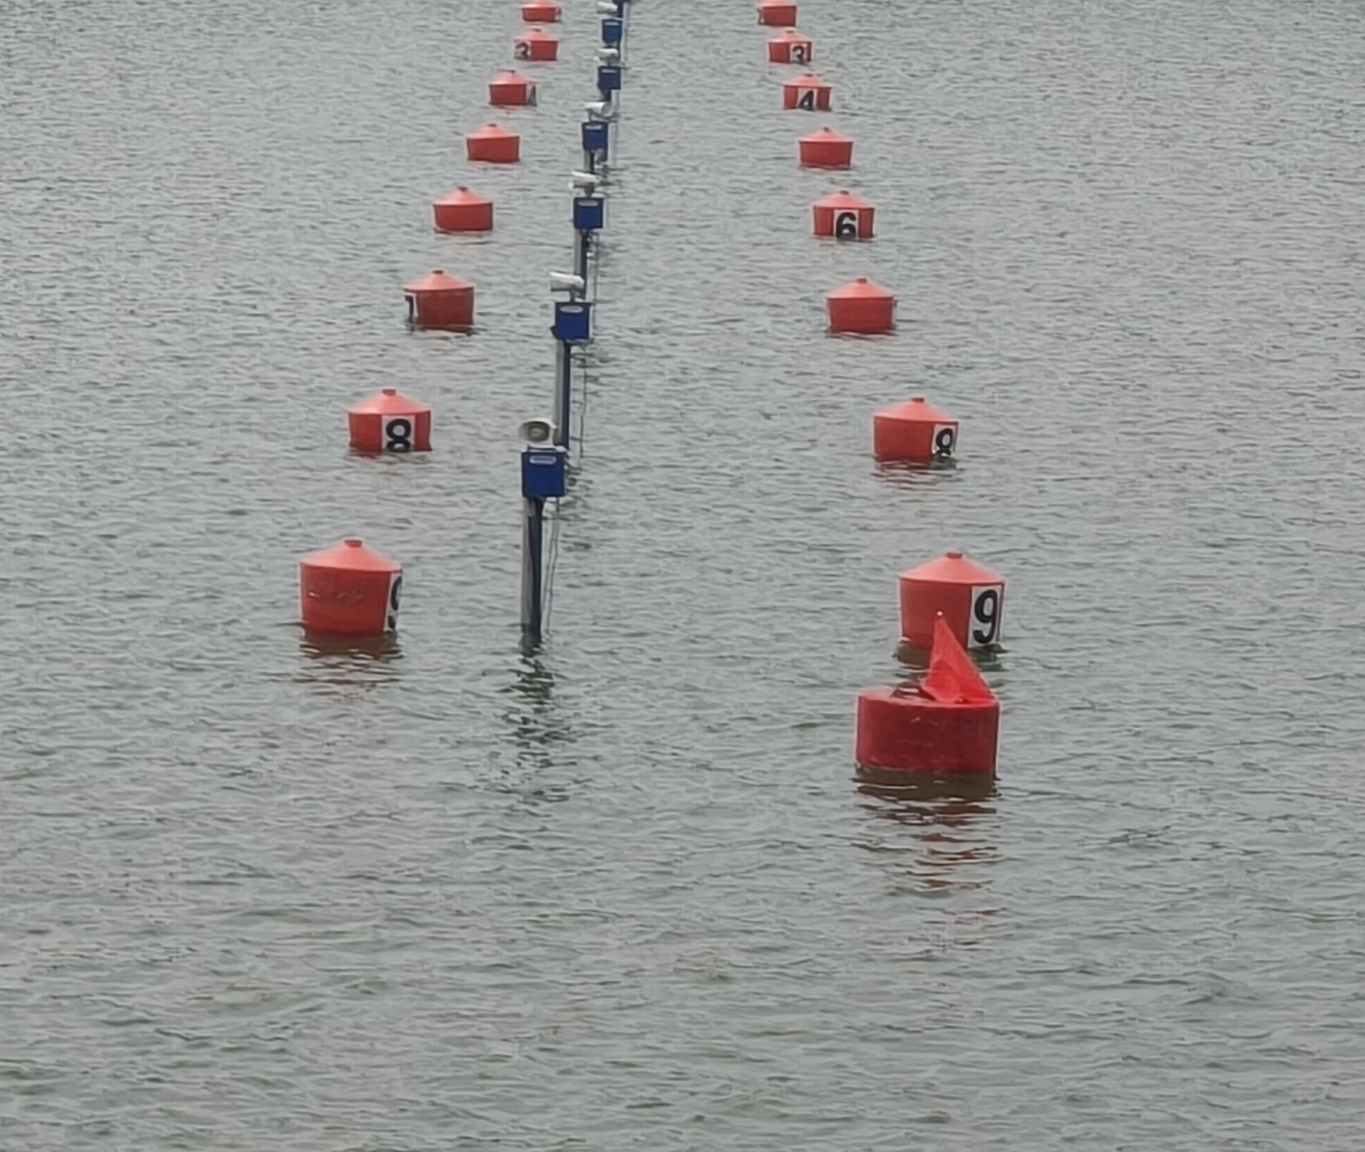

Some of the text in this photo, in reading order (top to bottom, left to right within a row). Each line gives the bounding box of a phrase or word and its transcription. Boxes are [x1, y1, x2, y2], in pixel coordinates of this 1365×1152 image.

[798, 89, 815, 111] 4
[835, 211, 857, 240] 6
[385, 418, 412, 453] 8
[972, 589, 998, 645] 9
